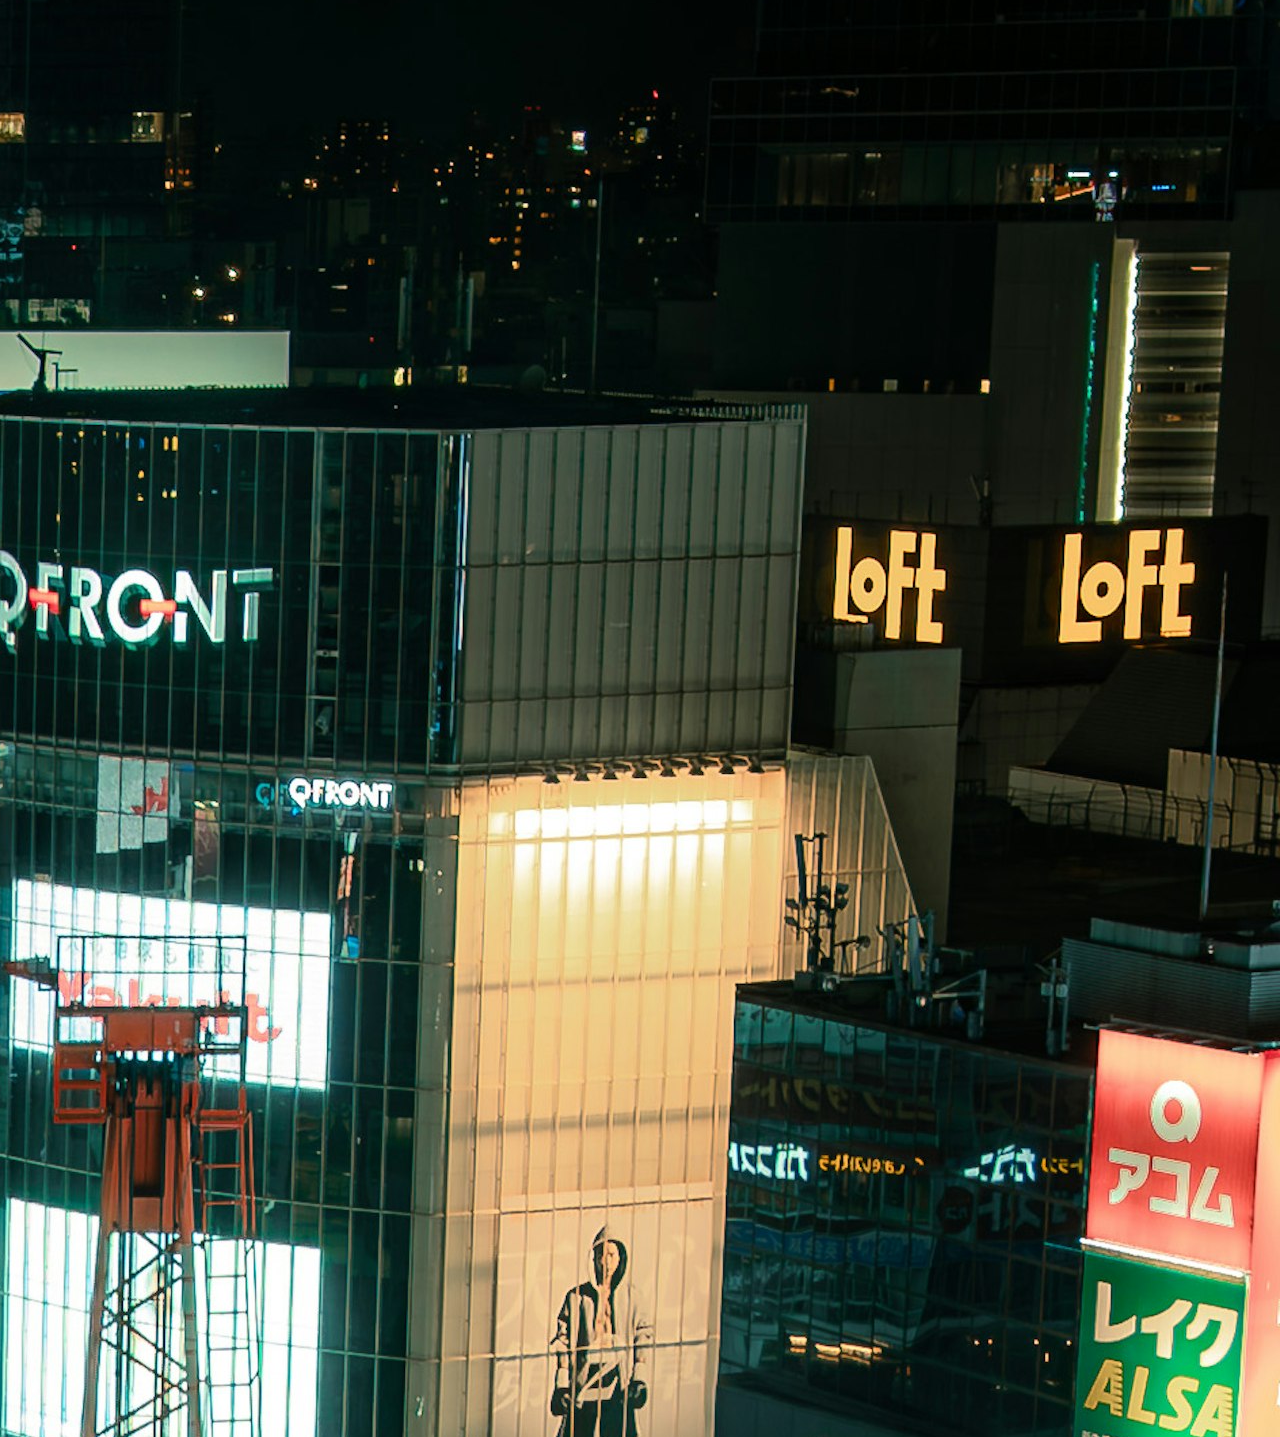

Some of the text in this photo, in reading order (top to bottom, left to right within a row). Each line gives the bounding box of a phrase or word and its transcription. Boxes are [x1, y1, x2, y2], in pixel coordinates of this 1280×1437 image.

[289, 778, 393, 808] QFRONT
[1107, 1146, 1235, 1229] アコム
[1093, 1280, 1240, 1369] レイク
